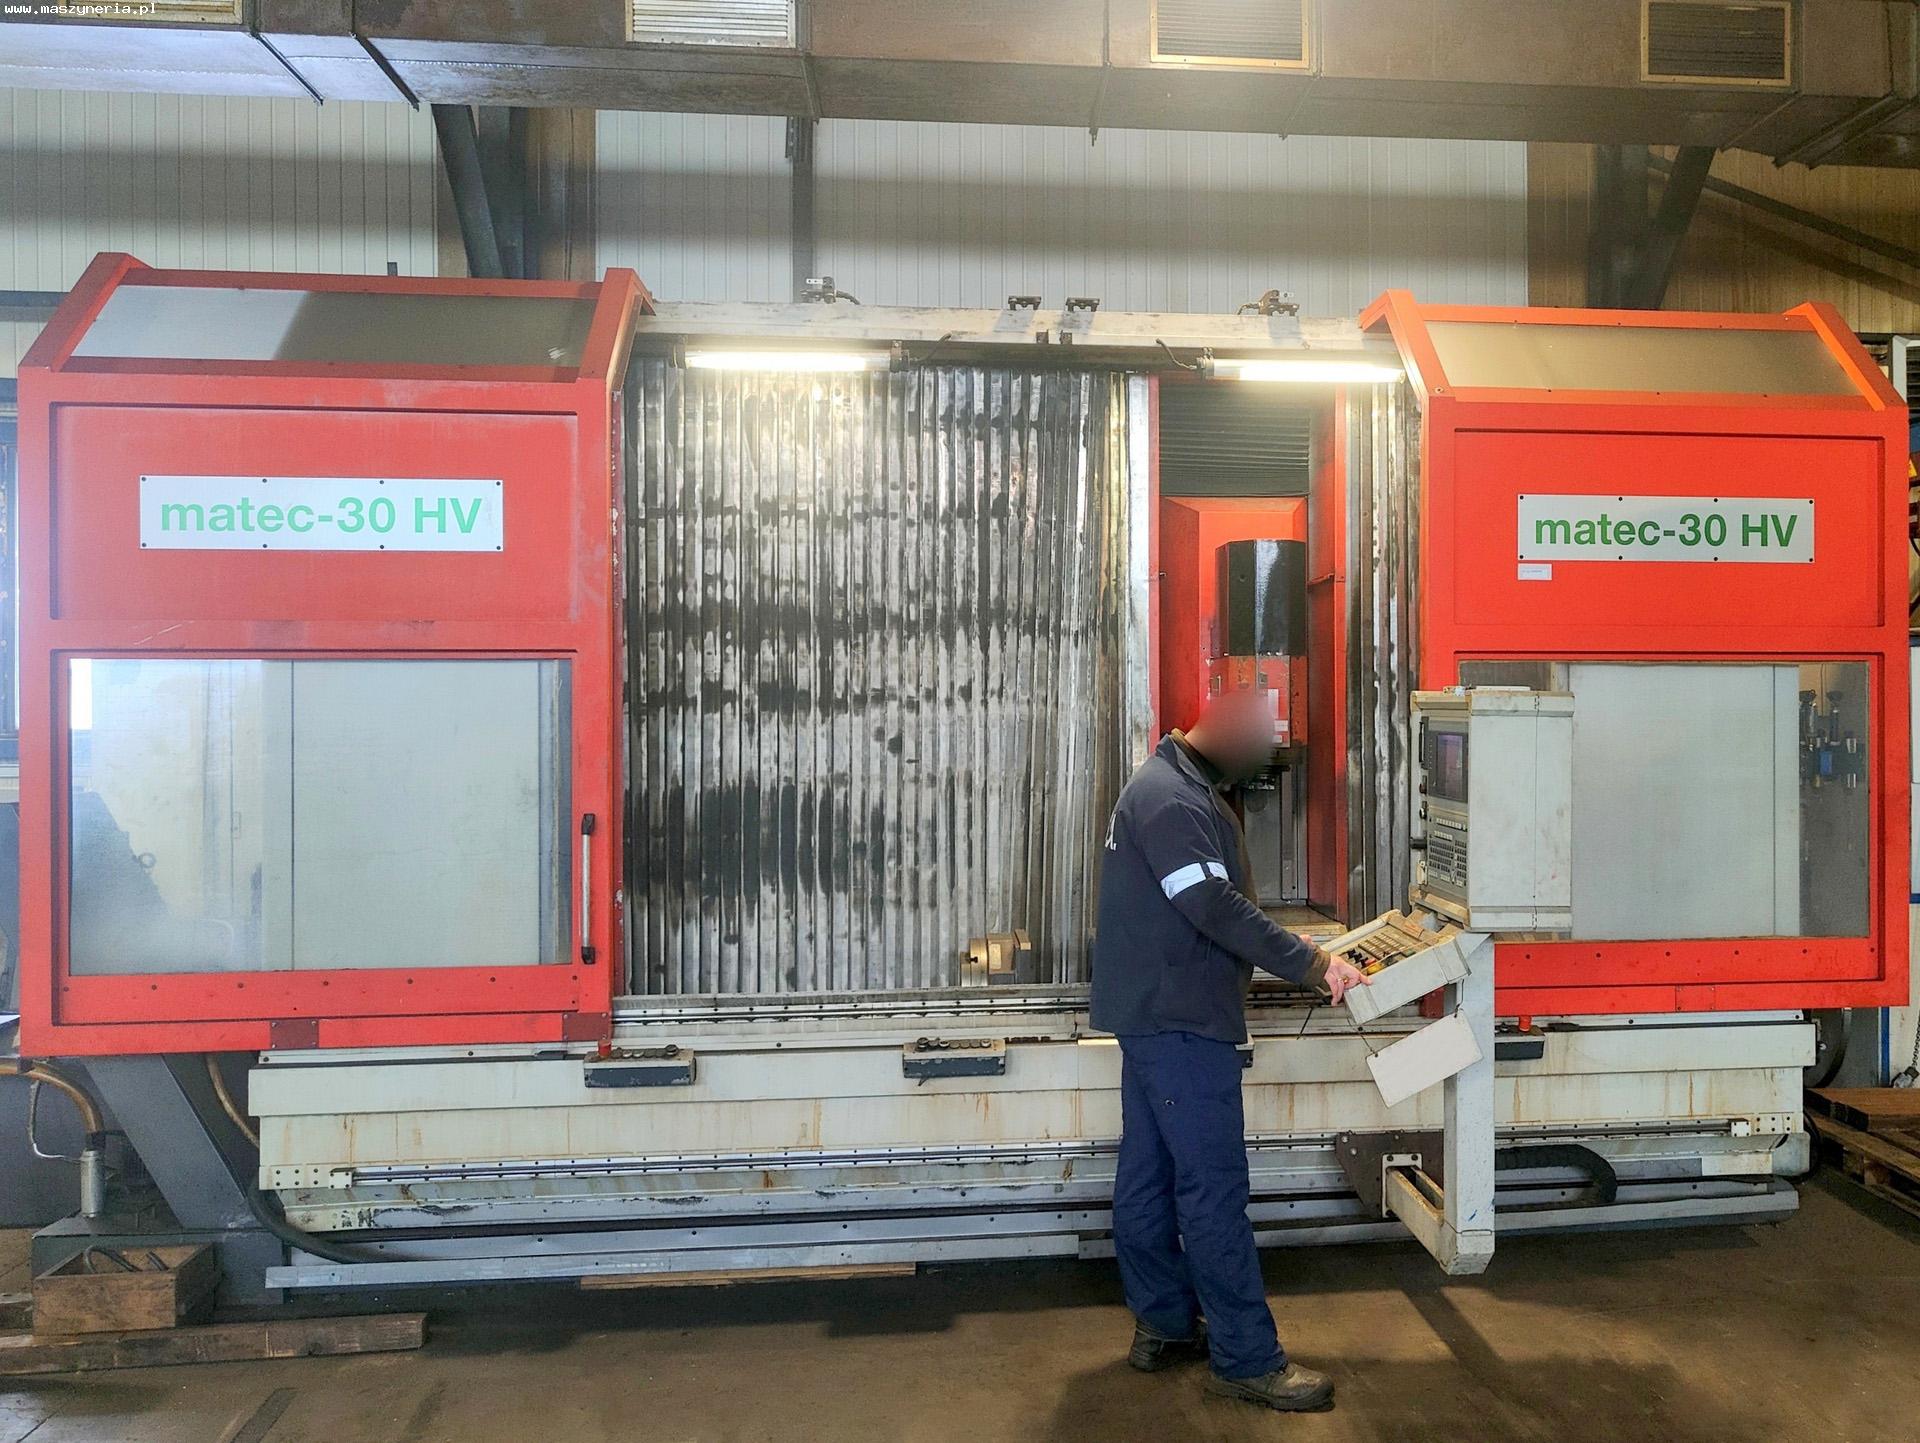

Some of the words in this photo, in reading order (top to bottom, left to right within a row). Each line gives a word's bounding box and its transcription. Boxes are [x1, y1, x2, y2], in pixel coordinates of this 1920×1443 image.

[161, 496, 396, 533] matec-30
[413, 497, 482, 533] HV
[1535, 513, 1727, 547] matec-30
[1741, 514, 1798, 548] HV
